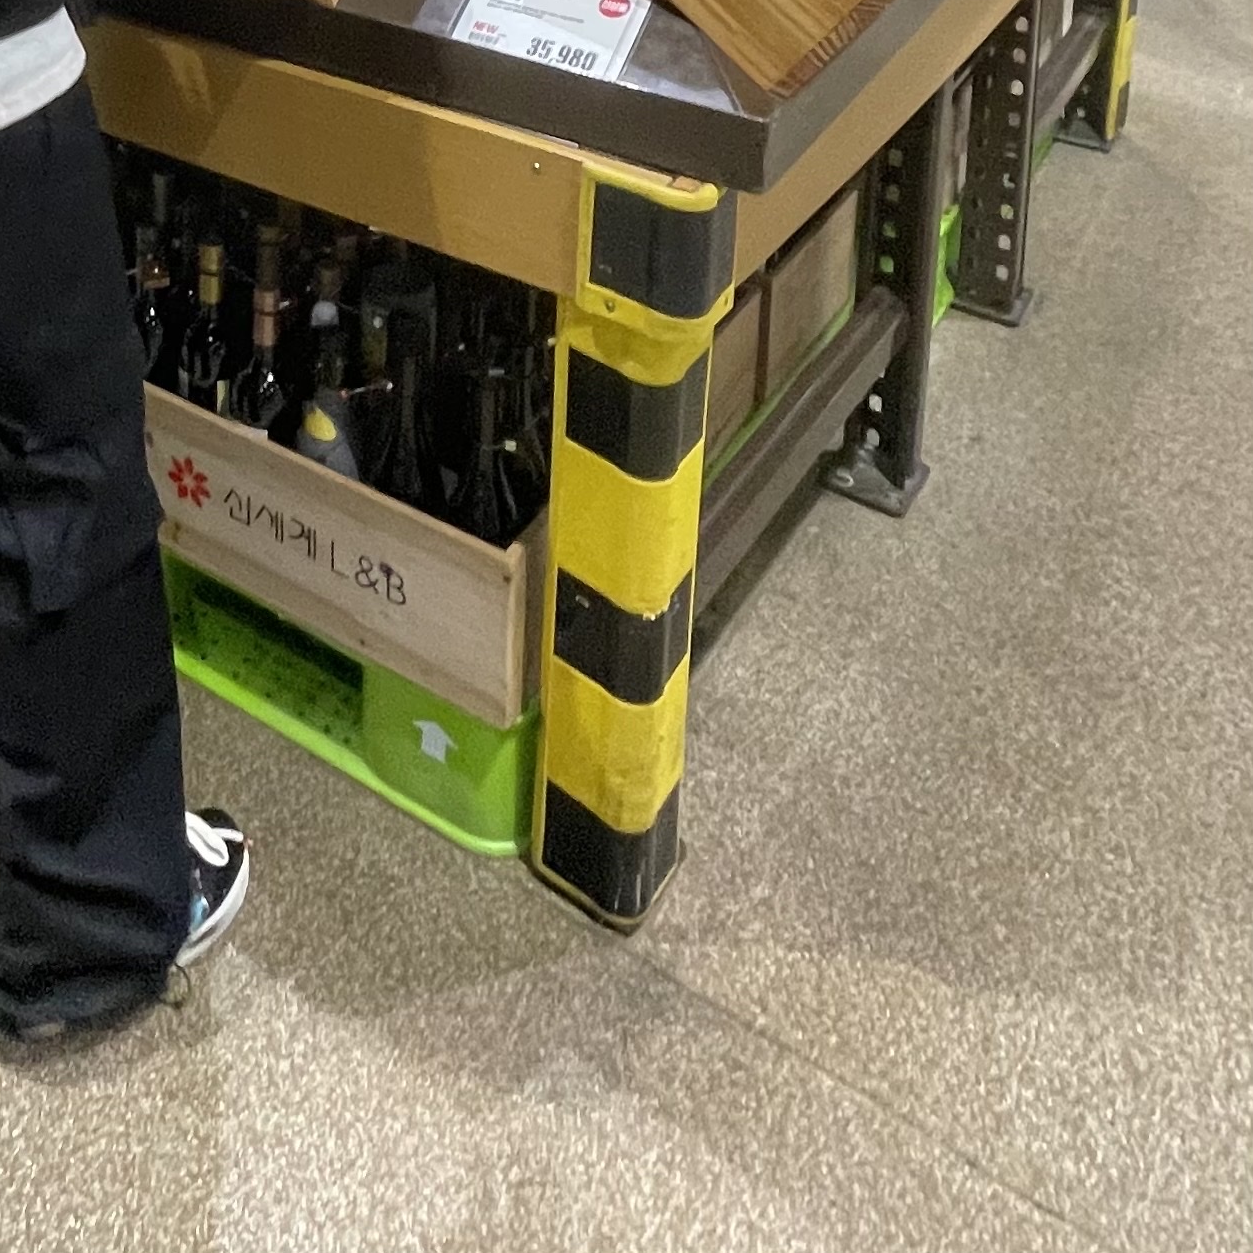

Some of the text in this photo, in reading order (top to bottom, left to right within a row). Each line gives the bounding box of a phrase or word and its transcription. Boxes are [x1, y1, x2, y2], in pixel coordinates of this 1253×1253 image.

[526, 36, 598, 71] 35,980
[224, 488, 407, 605] 신세계 L&B
